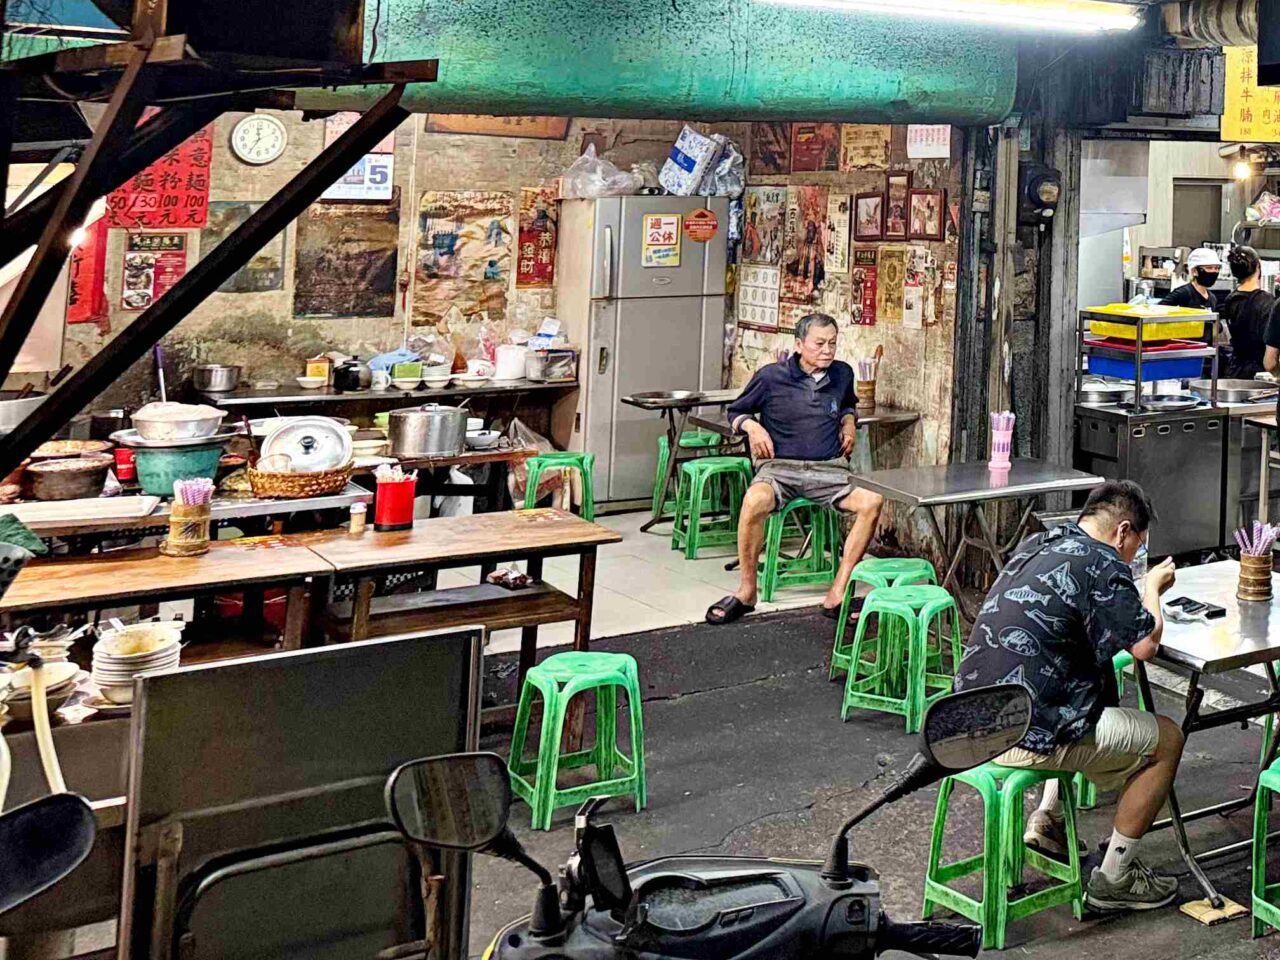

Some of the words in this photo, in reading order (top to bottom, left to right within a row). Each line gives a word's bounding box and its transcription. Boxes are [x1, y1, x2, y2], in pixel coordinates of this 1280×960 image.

[368, 164, 389, 185] 5
[650, 217, 675, 230] 週一
[649, 230, 674, 243] 公休
[520, 241, 537, 275] 發財
